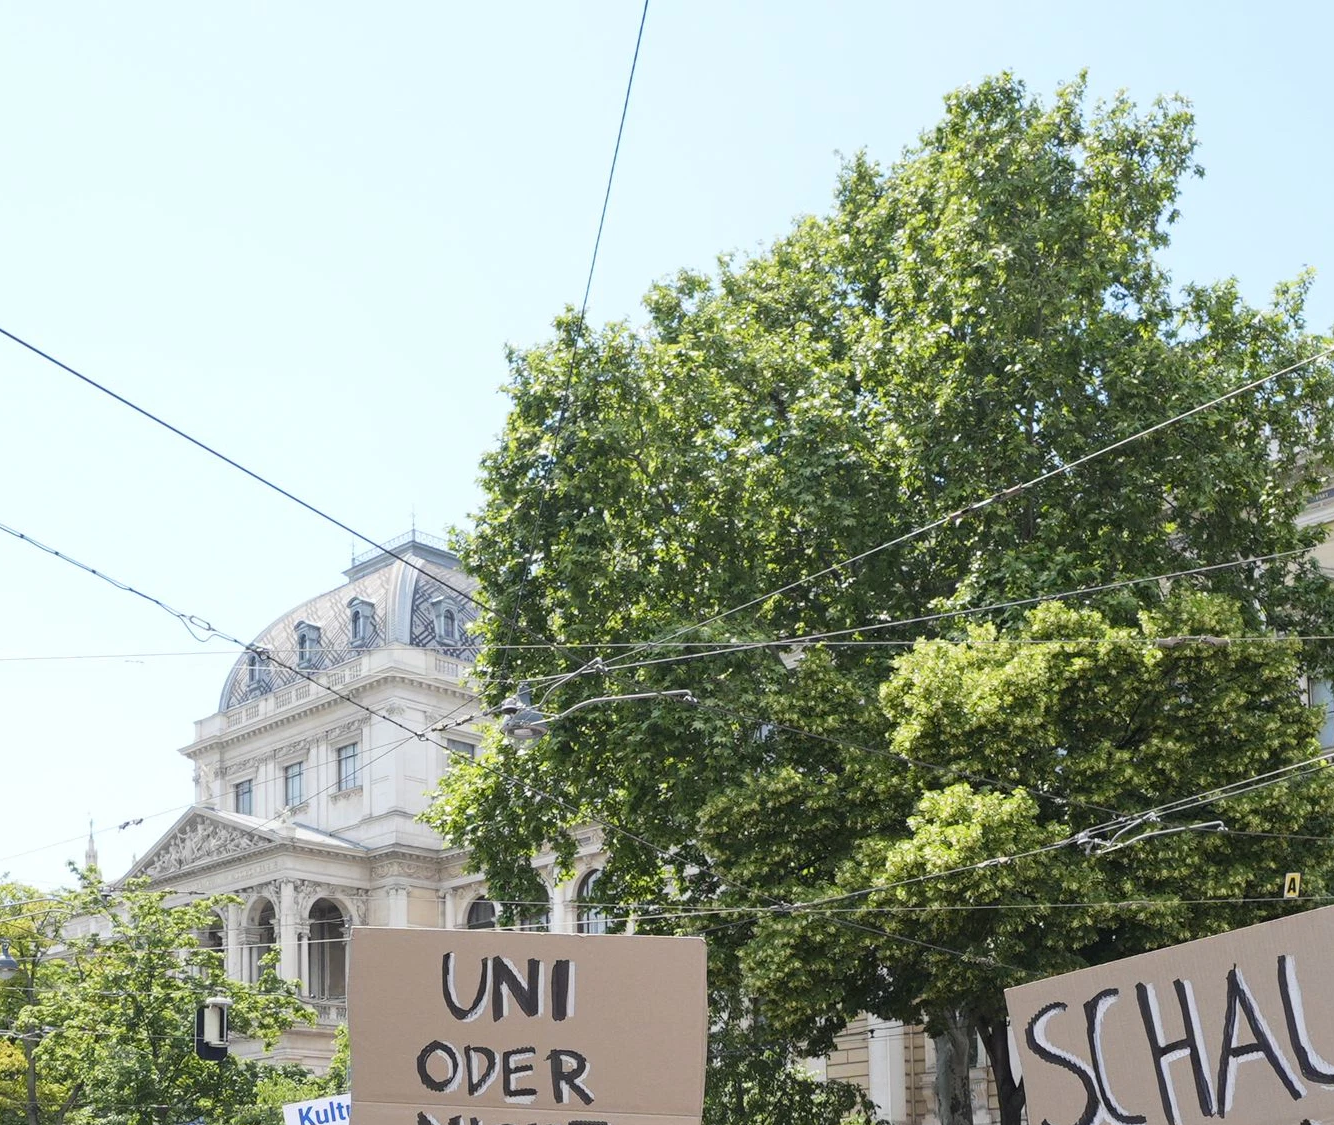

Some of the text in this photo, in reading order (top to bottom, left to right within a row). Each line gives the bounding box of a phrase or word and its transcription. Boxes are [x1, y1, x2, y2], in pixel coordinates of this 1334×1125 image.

[1287, 877, 1296, 893] A
[442, 951, 576, 1022] UNI
[417, 1039, 595, 1105] ODER
